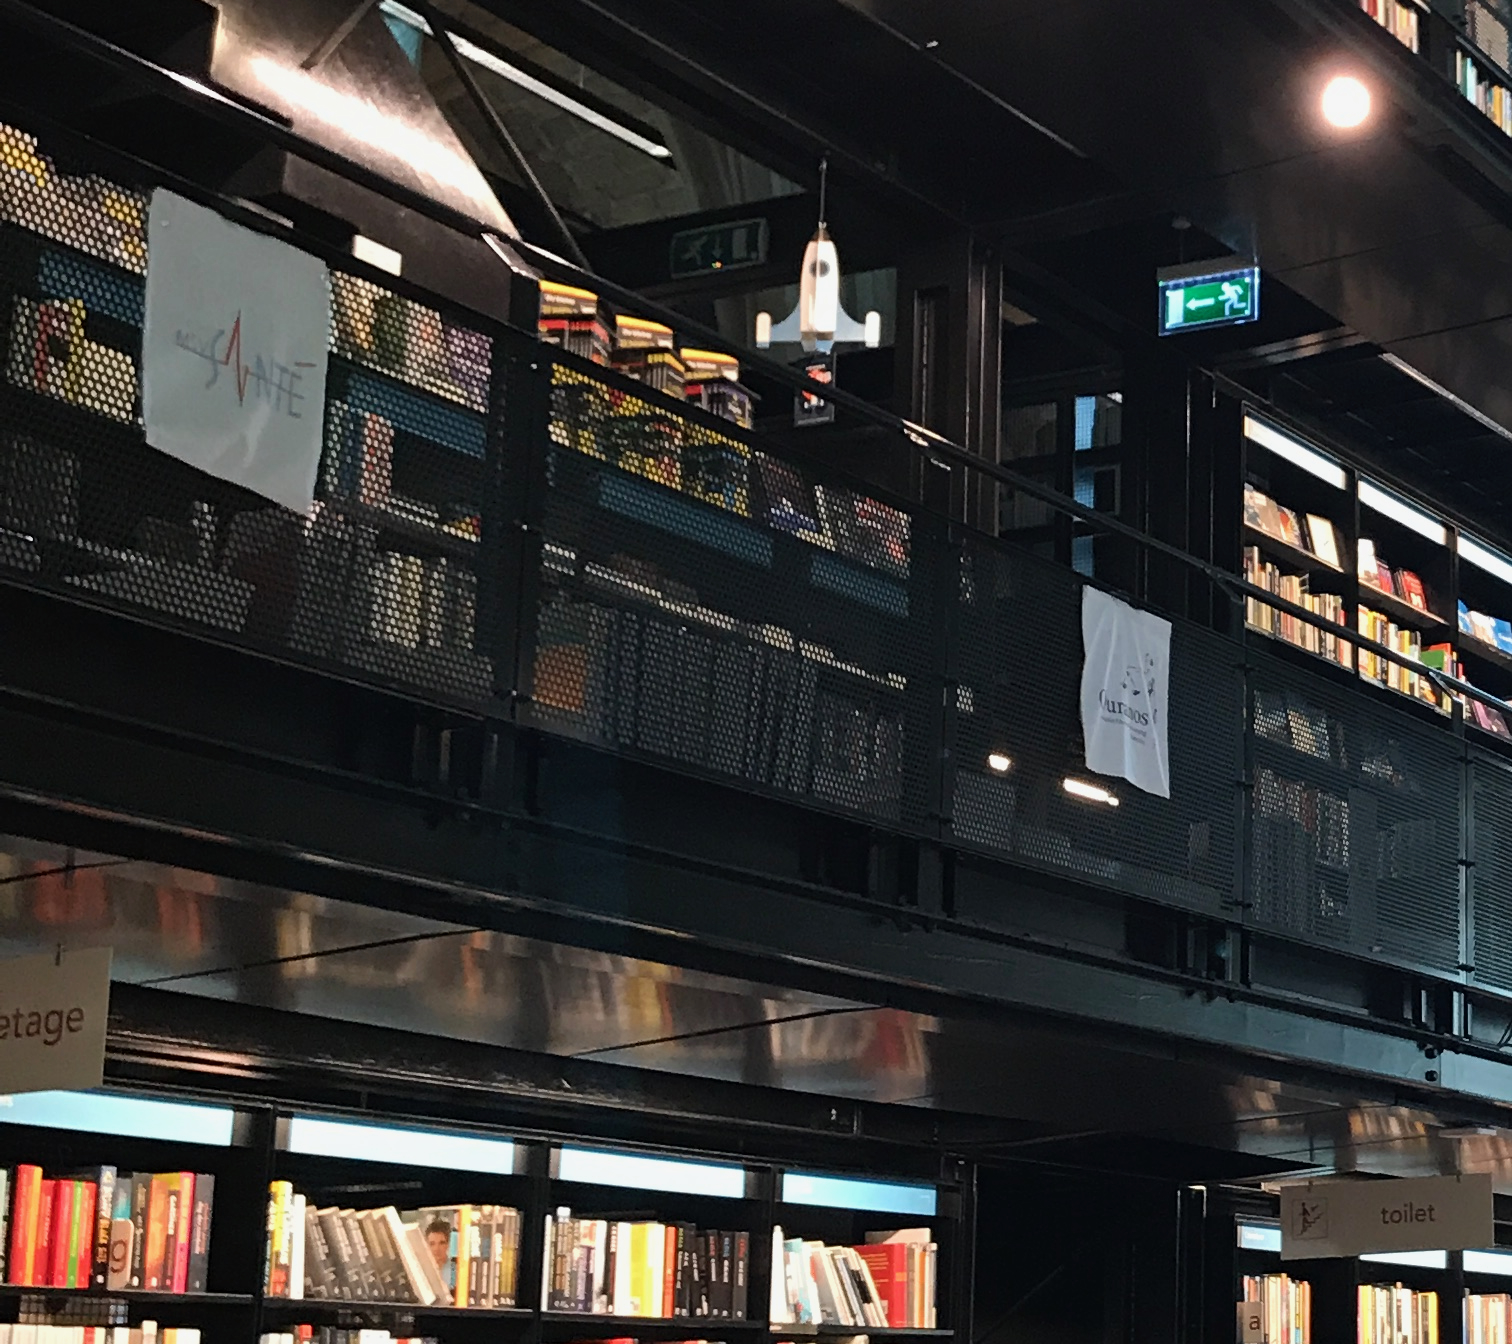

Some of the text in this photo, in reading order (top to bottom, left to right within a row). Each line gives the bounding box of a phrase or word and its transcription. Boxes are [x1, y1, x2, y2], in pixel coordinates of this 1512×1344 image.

[0, 1007, 85, 1046] etage
[1380, 1203, 1436, 1225] toilet
[111, 1239, 127, 1274] g
